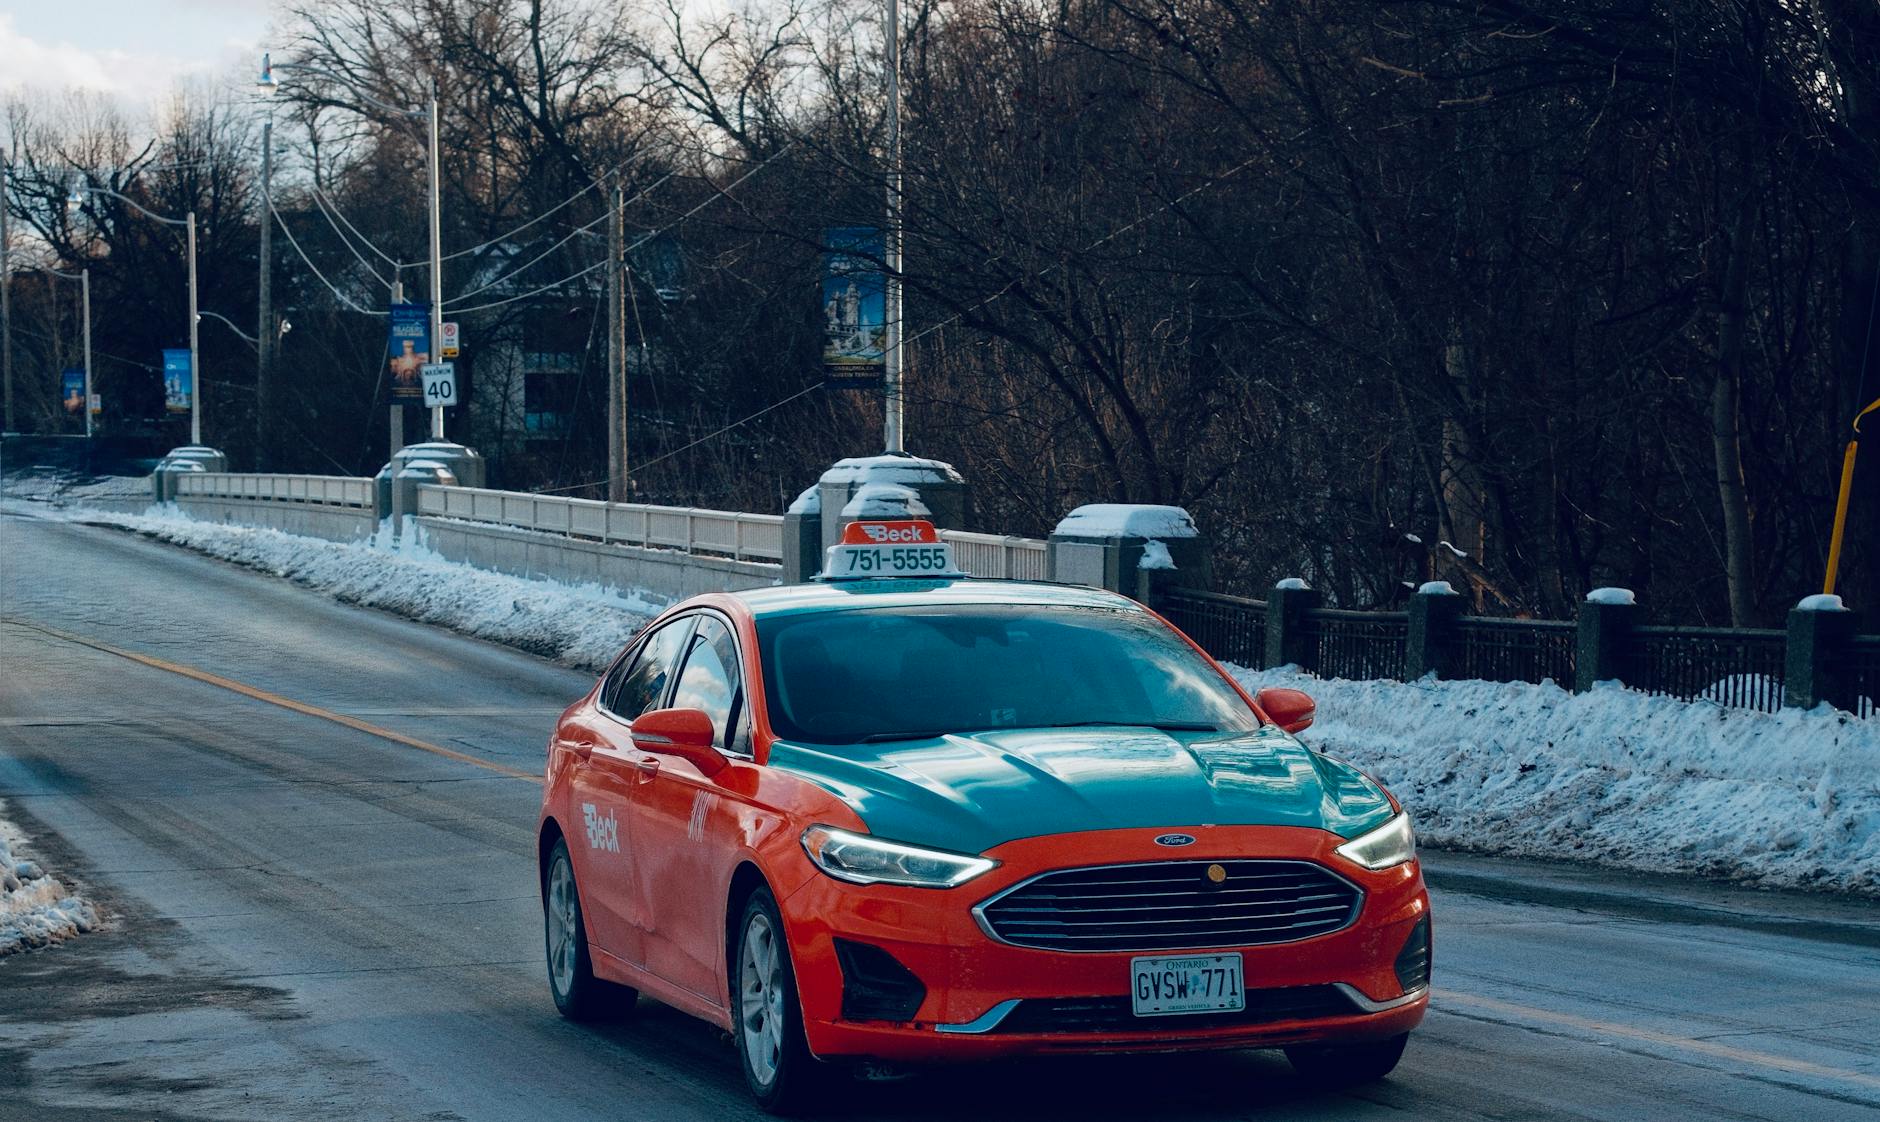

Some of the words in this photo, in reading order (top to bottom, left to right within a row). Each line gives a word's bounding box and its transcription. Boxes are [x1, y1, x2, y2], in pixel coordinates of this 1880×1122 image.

[425, 368, 451, 376] MAXIMUM
[428, 380, 452, 399] 40
[862, 525, 923, 541] Beck
[845, 548, 946, 571] 751-5555
[582, 803, 620, 854] Beck
[1163, 836, 1187, 844] Ford
[1137, 970, 1188, 1001] GVSW
[1201, 968, 1238, 997] 771
